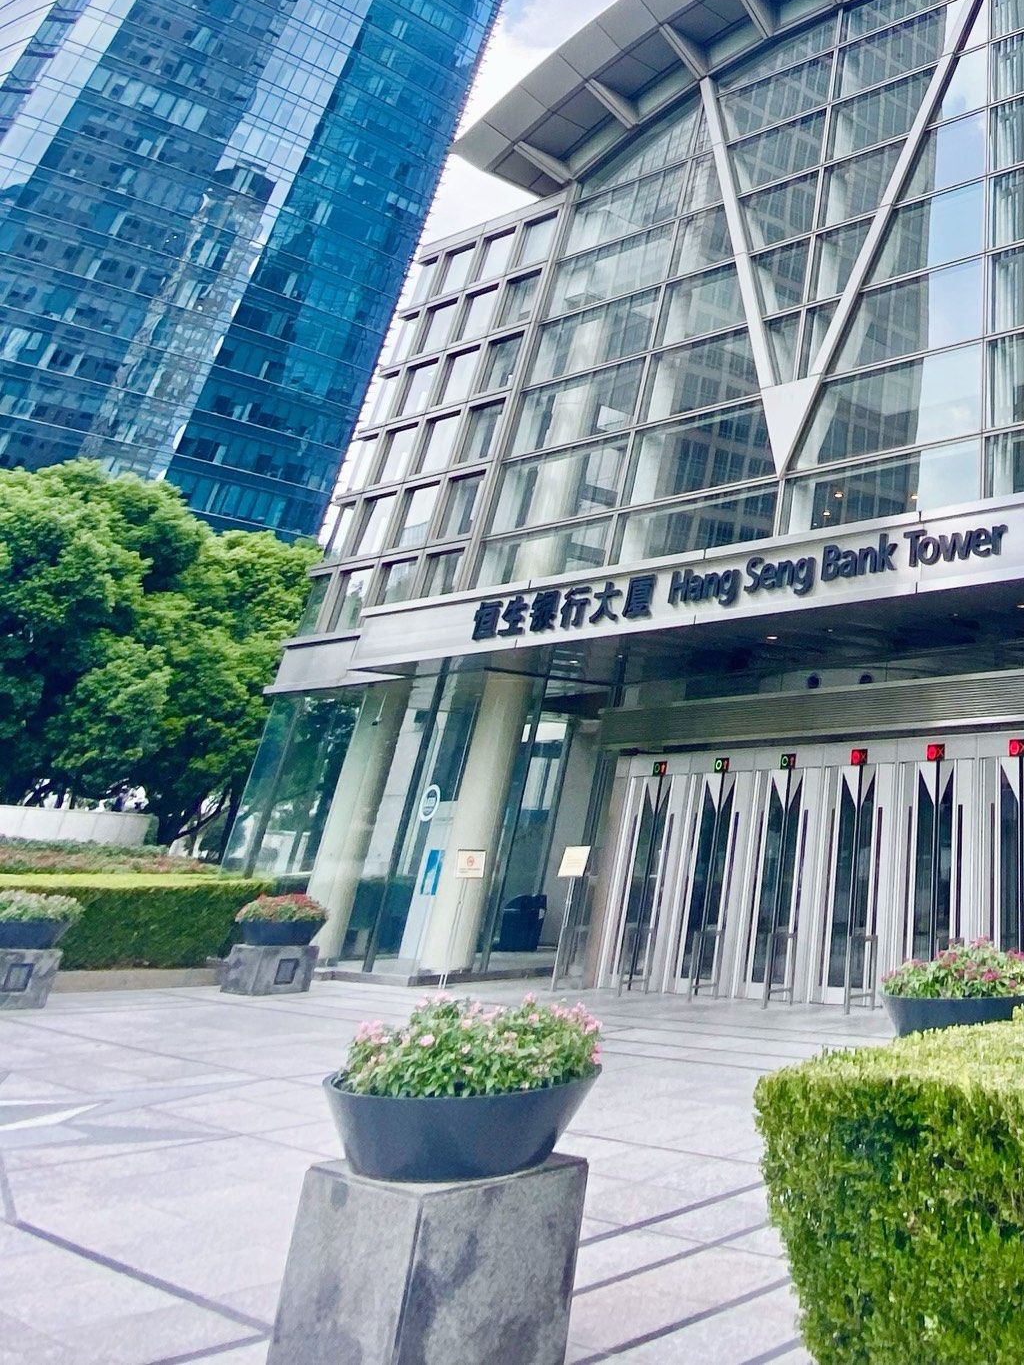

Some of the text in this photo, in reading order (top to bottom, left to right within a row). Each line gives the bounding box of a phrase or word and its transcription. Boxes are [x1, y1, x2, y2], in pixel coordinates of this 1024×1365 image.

[667, 524, 1009, 607] Hang Seng Bank Tower
[472, 573, 658, 641] 恒生银行大厦
